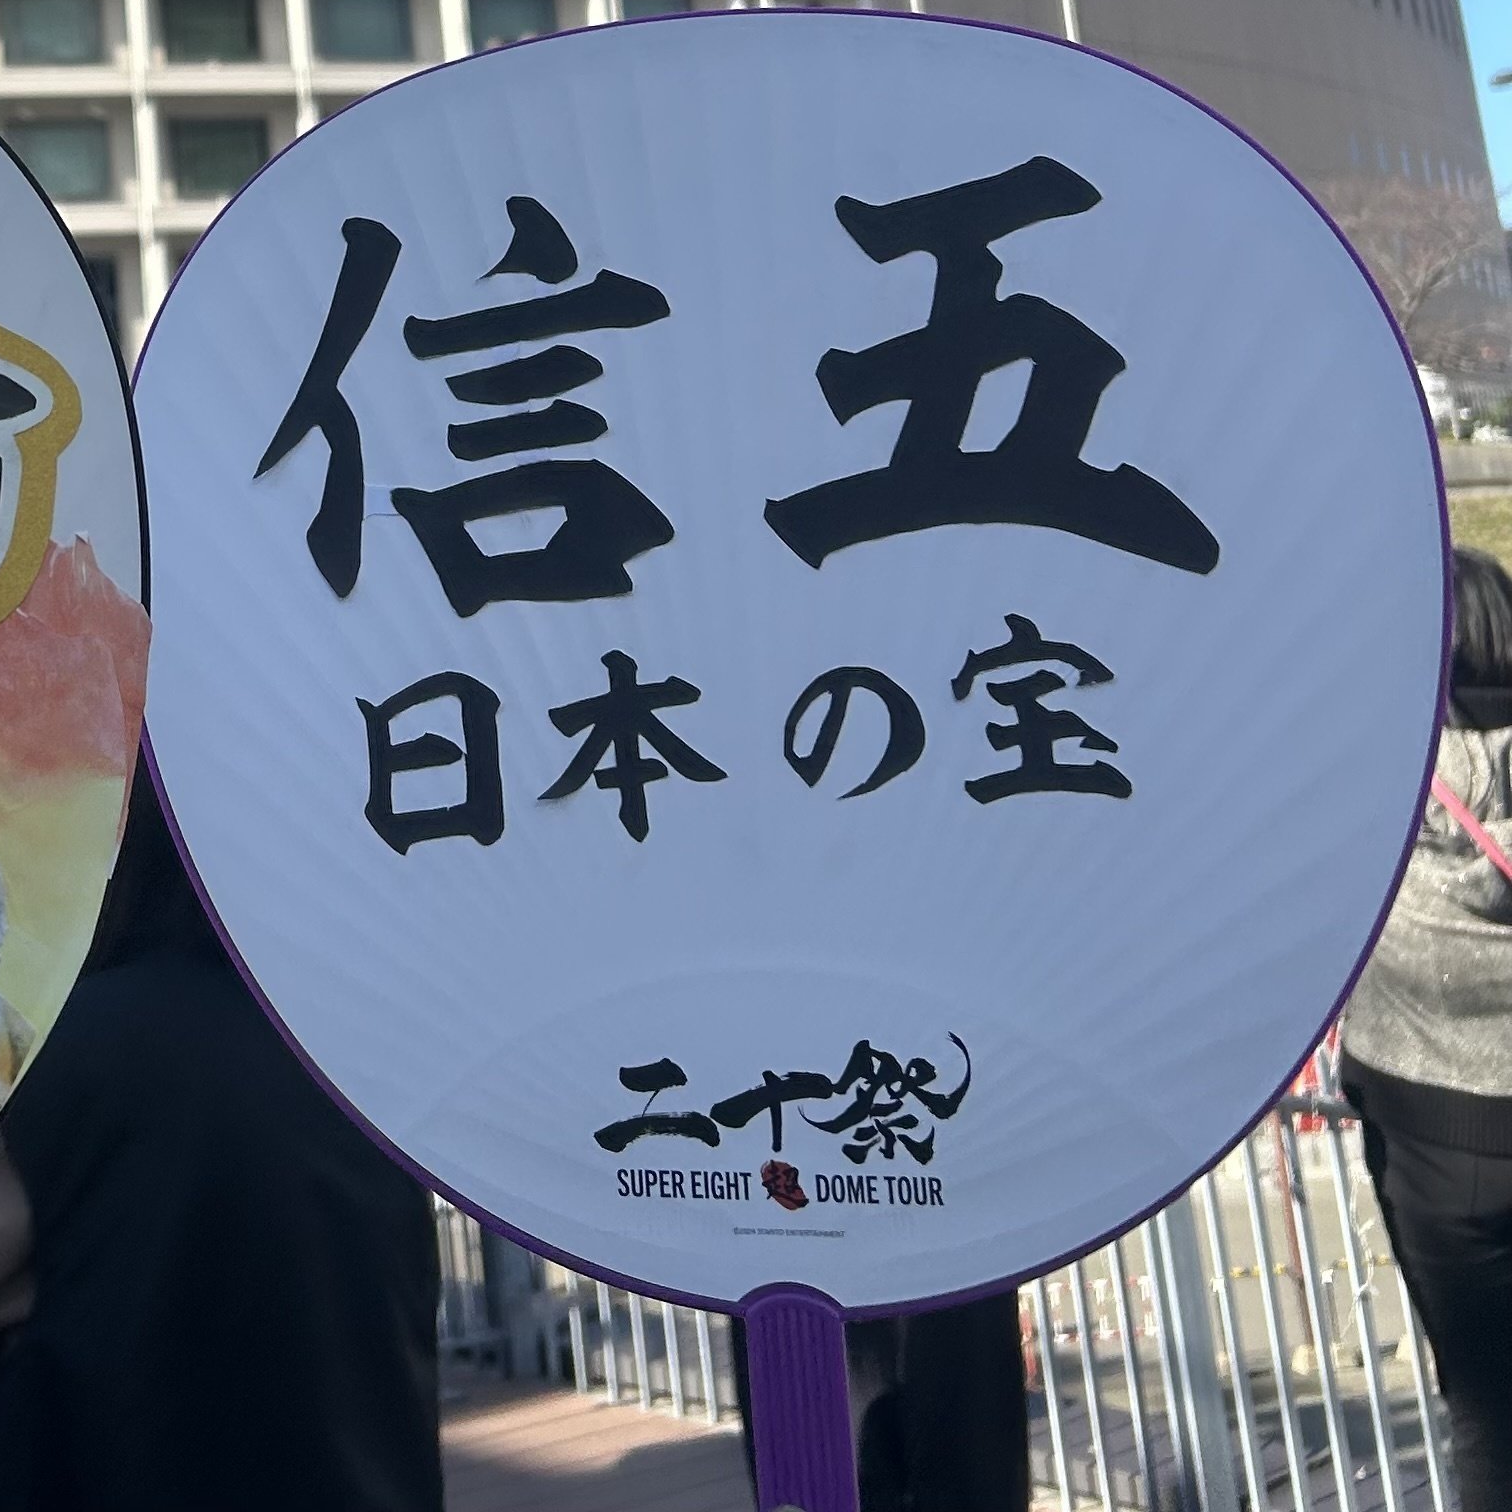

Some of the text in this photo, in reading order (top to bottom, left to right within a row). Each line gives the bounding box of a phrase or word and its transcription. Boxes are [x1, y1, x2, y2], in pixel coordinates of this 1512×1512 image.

[356, 614, 1131, 854] 日本の宝
[594, 1031, 970, 1165] 二十祭
[617, 1168, 685, 1199] SUPER
[690, 1170, 752, 1200] EIGHT
[815, 1173, 879, 1204] DOME
[884, 1175, 944, 1206] TOUR
